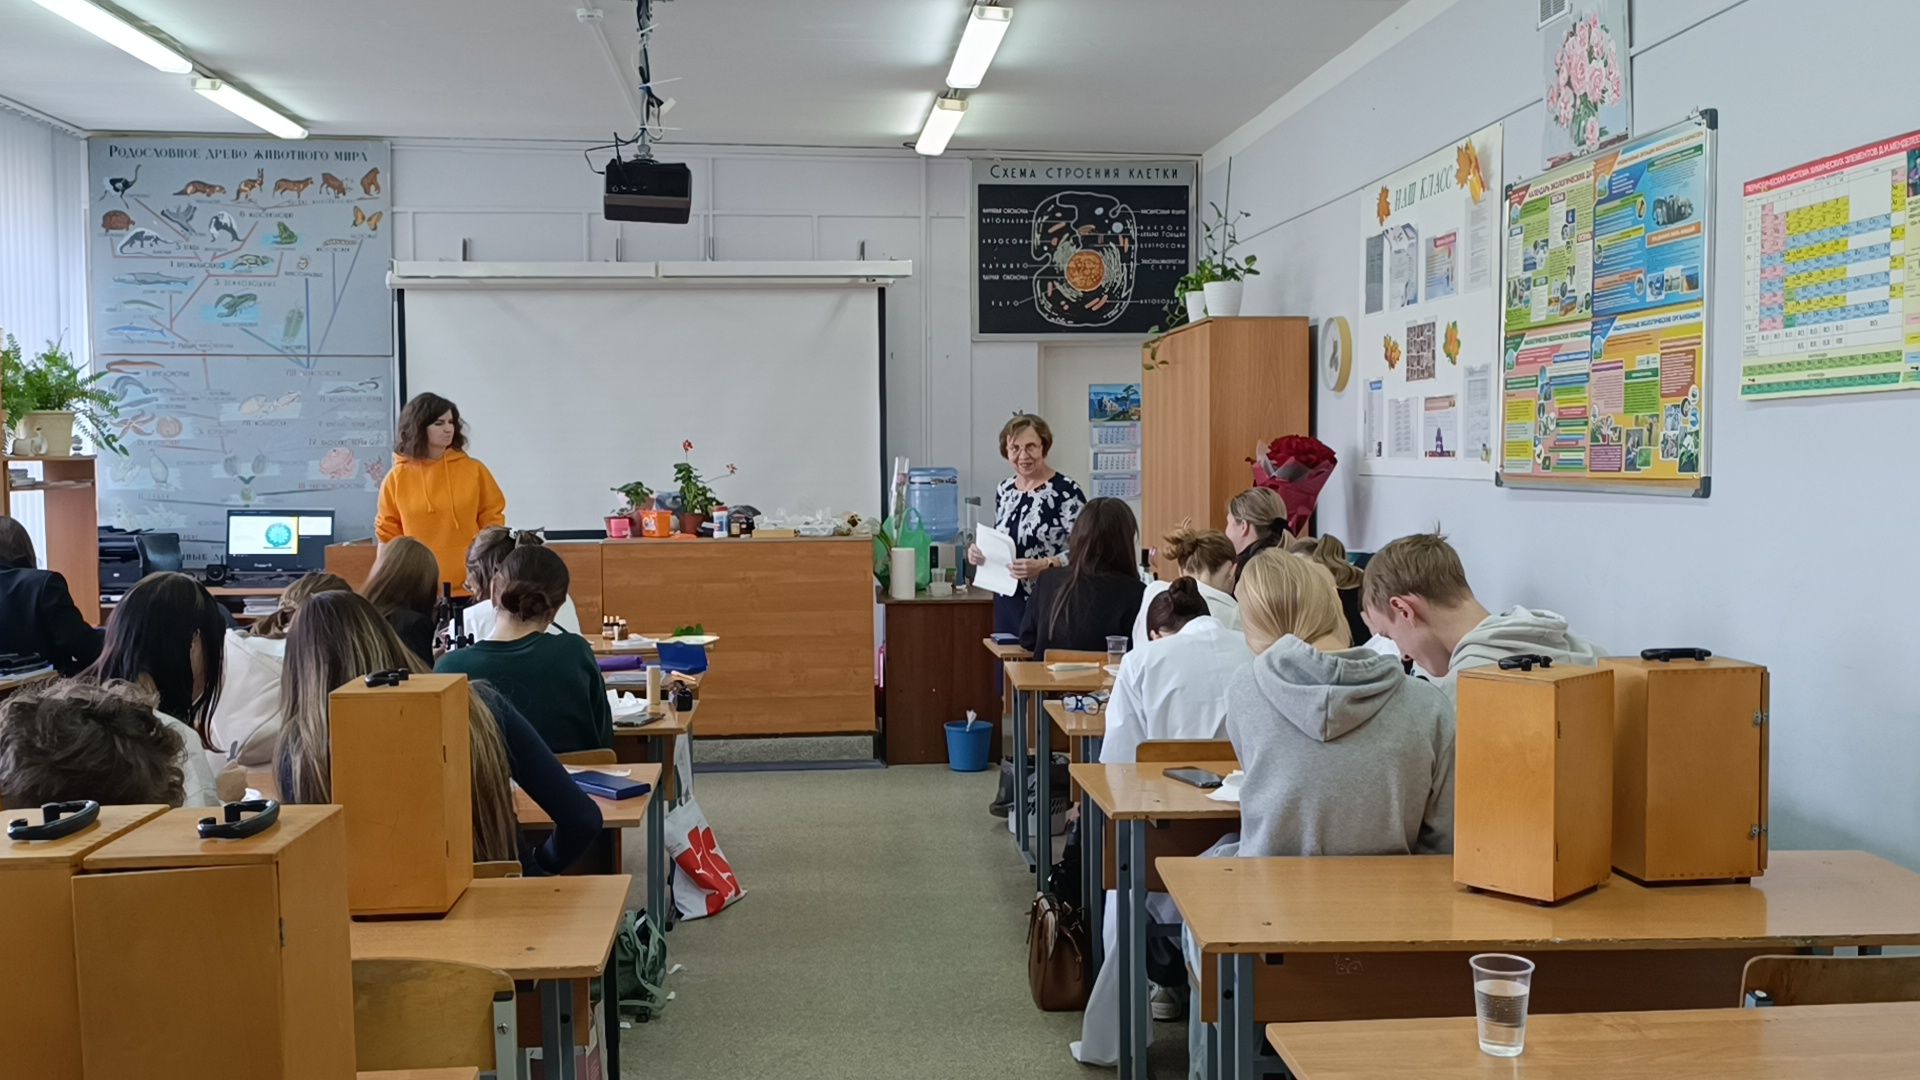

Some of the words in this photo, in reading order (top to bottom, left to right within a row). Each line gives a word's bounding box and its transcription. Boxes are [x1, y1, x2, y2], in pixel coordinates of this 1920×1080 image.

[109, 144, 201, 159] РОДОСЛОВНОЕ
[205, 147, 248, 161] ДРЕВО
[253, 148, 329, 162] ЖИВОТНОГО
[334, 149, 368, 163] МИРА
[990, 164, 1036, 179] СХЕМА
[1045, 167, 1120, 179] СТРОЕНИЯ
[1128, 167, 1179, 179] КЛЕТКИ
[1394, 181, 1417, 212] НАШ
[1420, 164, 1453, 200] КЛАСС
